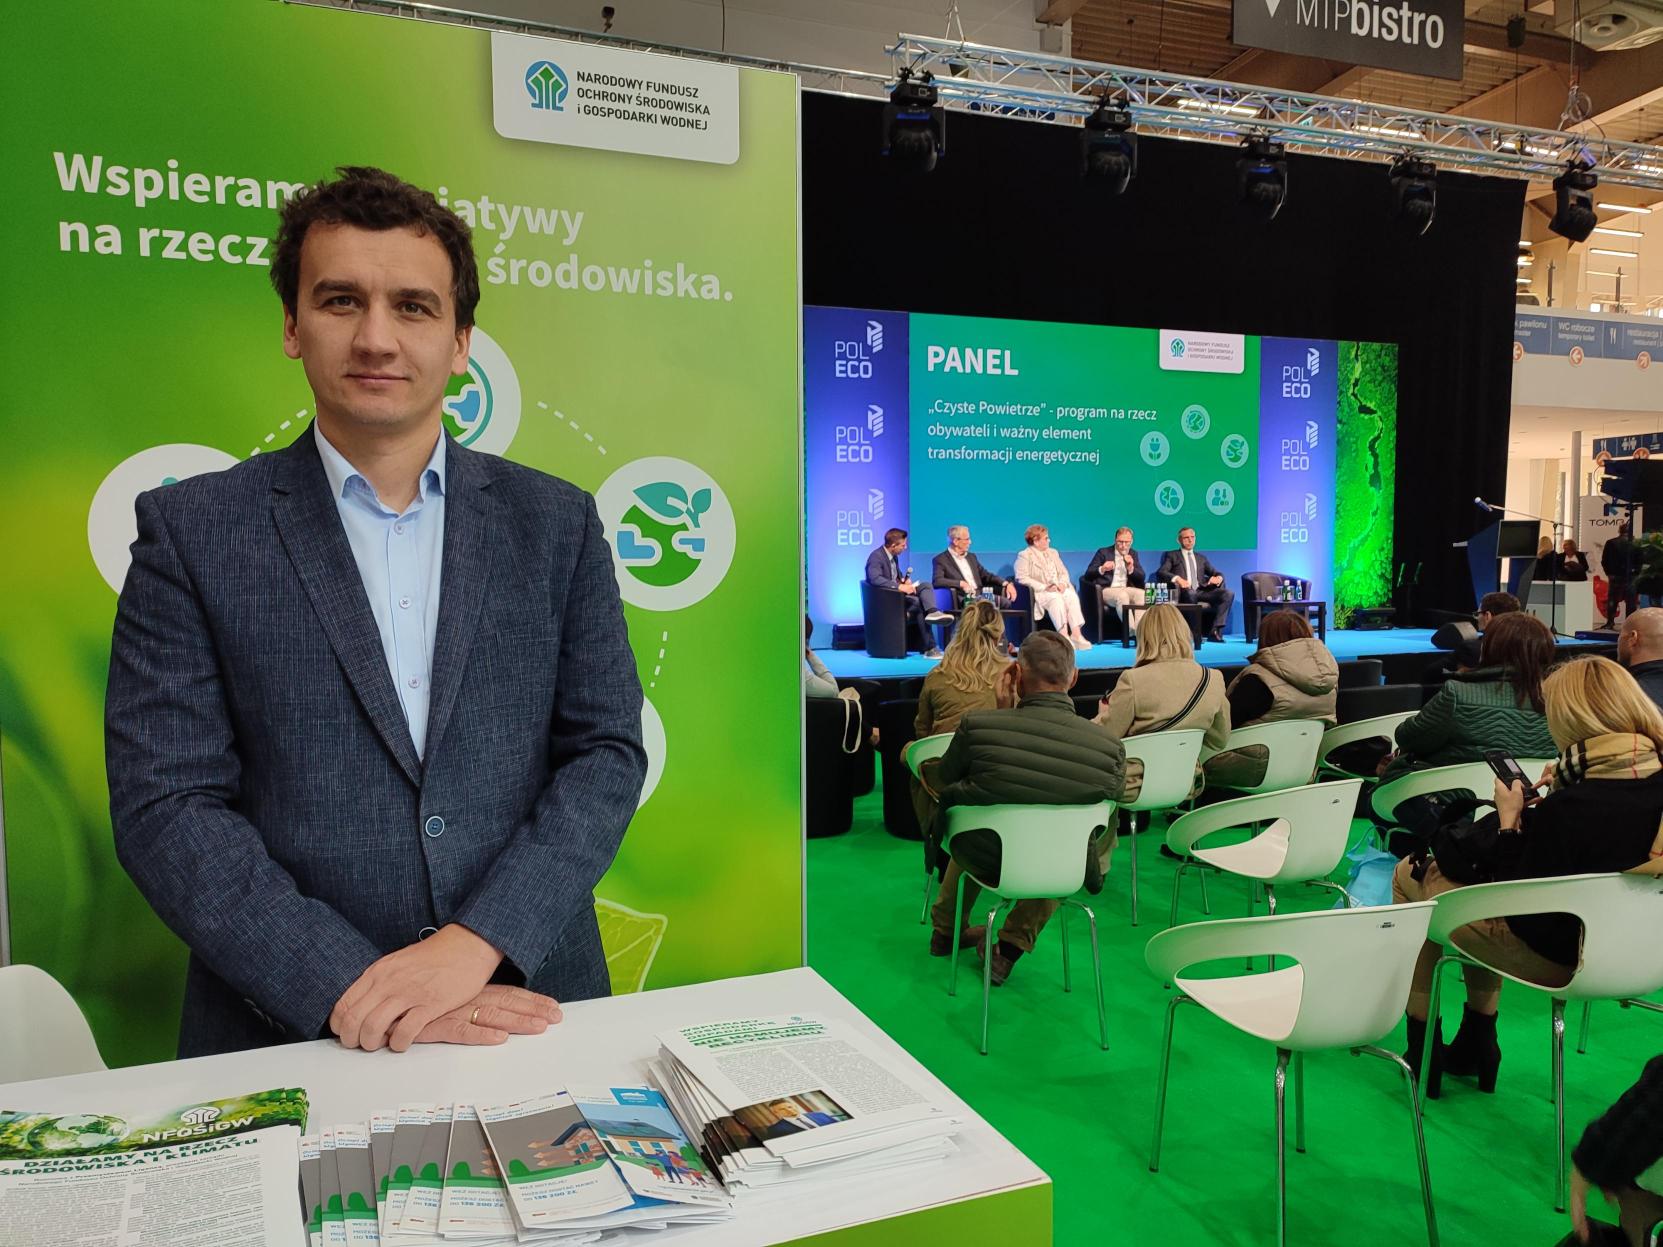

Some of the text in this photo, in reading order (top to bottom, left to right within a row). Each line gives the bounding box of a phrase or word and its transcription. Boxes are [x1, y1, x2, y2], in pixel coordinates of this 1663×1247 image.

[576, 71, 699, 98] NARODOWY FUNDUSZ
[576, 88, 711, 115] OCHRONY ŚRODOWISKA
[577, 104, 708, 130] i GOSPODARKI WODNEJ
[53, 152, 312, 208] Wspieram
[59, 221, 270, 266] na rzecz
[486, 242, 734, 301] środowiska.
[1558, 322, 1570, 330] WC
[835, 341, 869, 360] POL
[835, 360, 872, 378] ECO
[927, 345, 1019, 376] PANEL
[1282, 366, 1309, 382] POL
[1282, 383, 1310, 398] ECO
[928, 400, 976, 416] „Czyste
[1056, 406, 1108, 421] program
[1110, 408, 1124, 418] na
[1128, 408, 1157, 420] rzecz
[836, 426, 870, 444] POL
[928, 422, 1092, 442] obywateli i ważny element
[836, 445, 873, 462] ECO
[928, 446, 1100, 466] transformacji energetycznej
[1282, 440, 1307, 454] POL
[1282, 456, 1310, 470] ECO
[836, 510, 870, 528] POL
[1281, 512, 1306, 526] POL
[837, 529, 873, 546] ECO
[1281, 529, 1308, 542] ECO
[0, 1159, 145, 1176] ŚRODOWISKA
[166, 1138, 258, 1160] KLIMATU
[24, 1136, 238, 1168] DZIAŁAMY NA RZECZ
